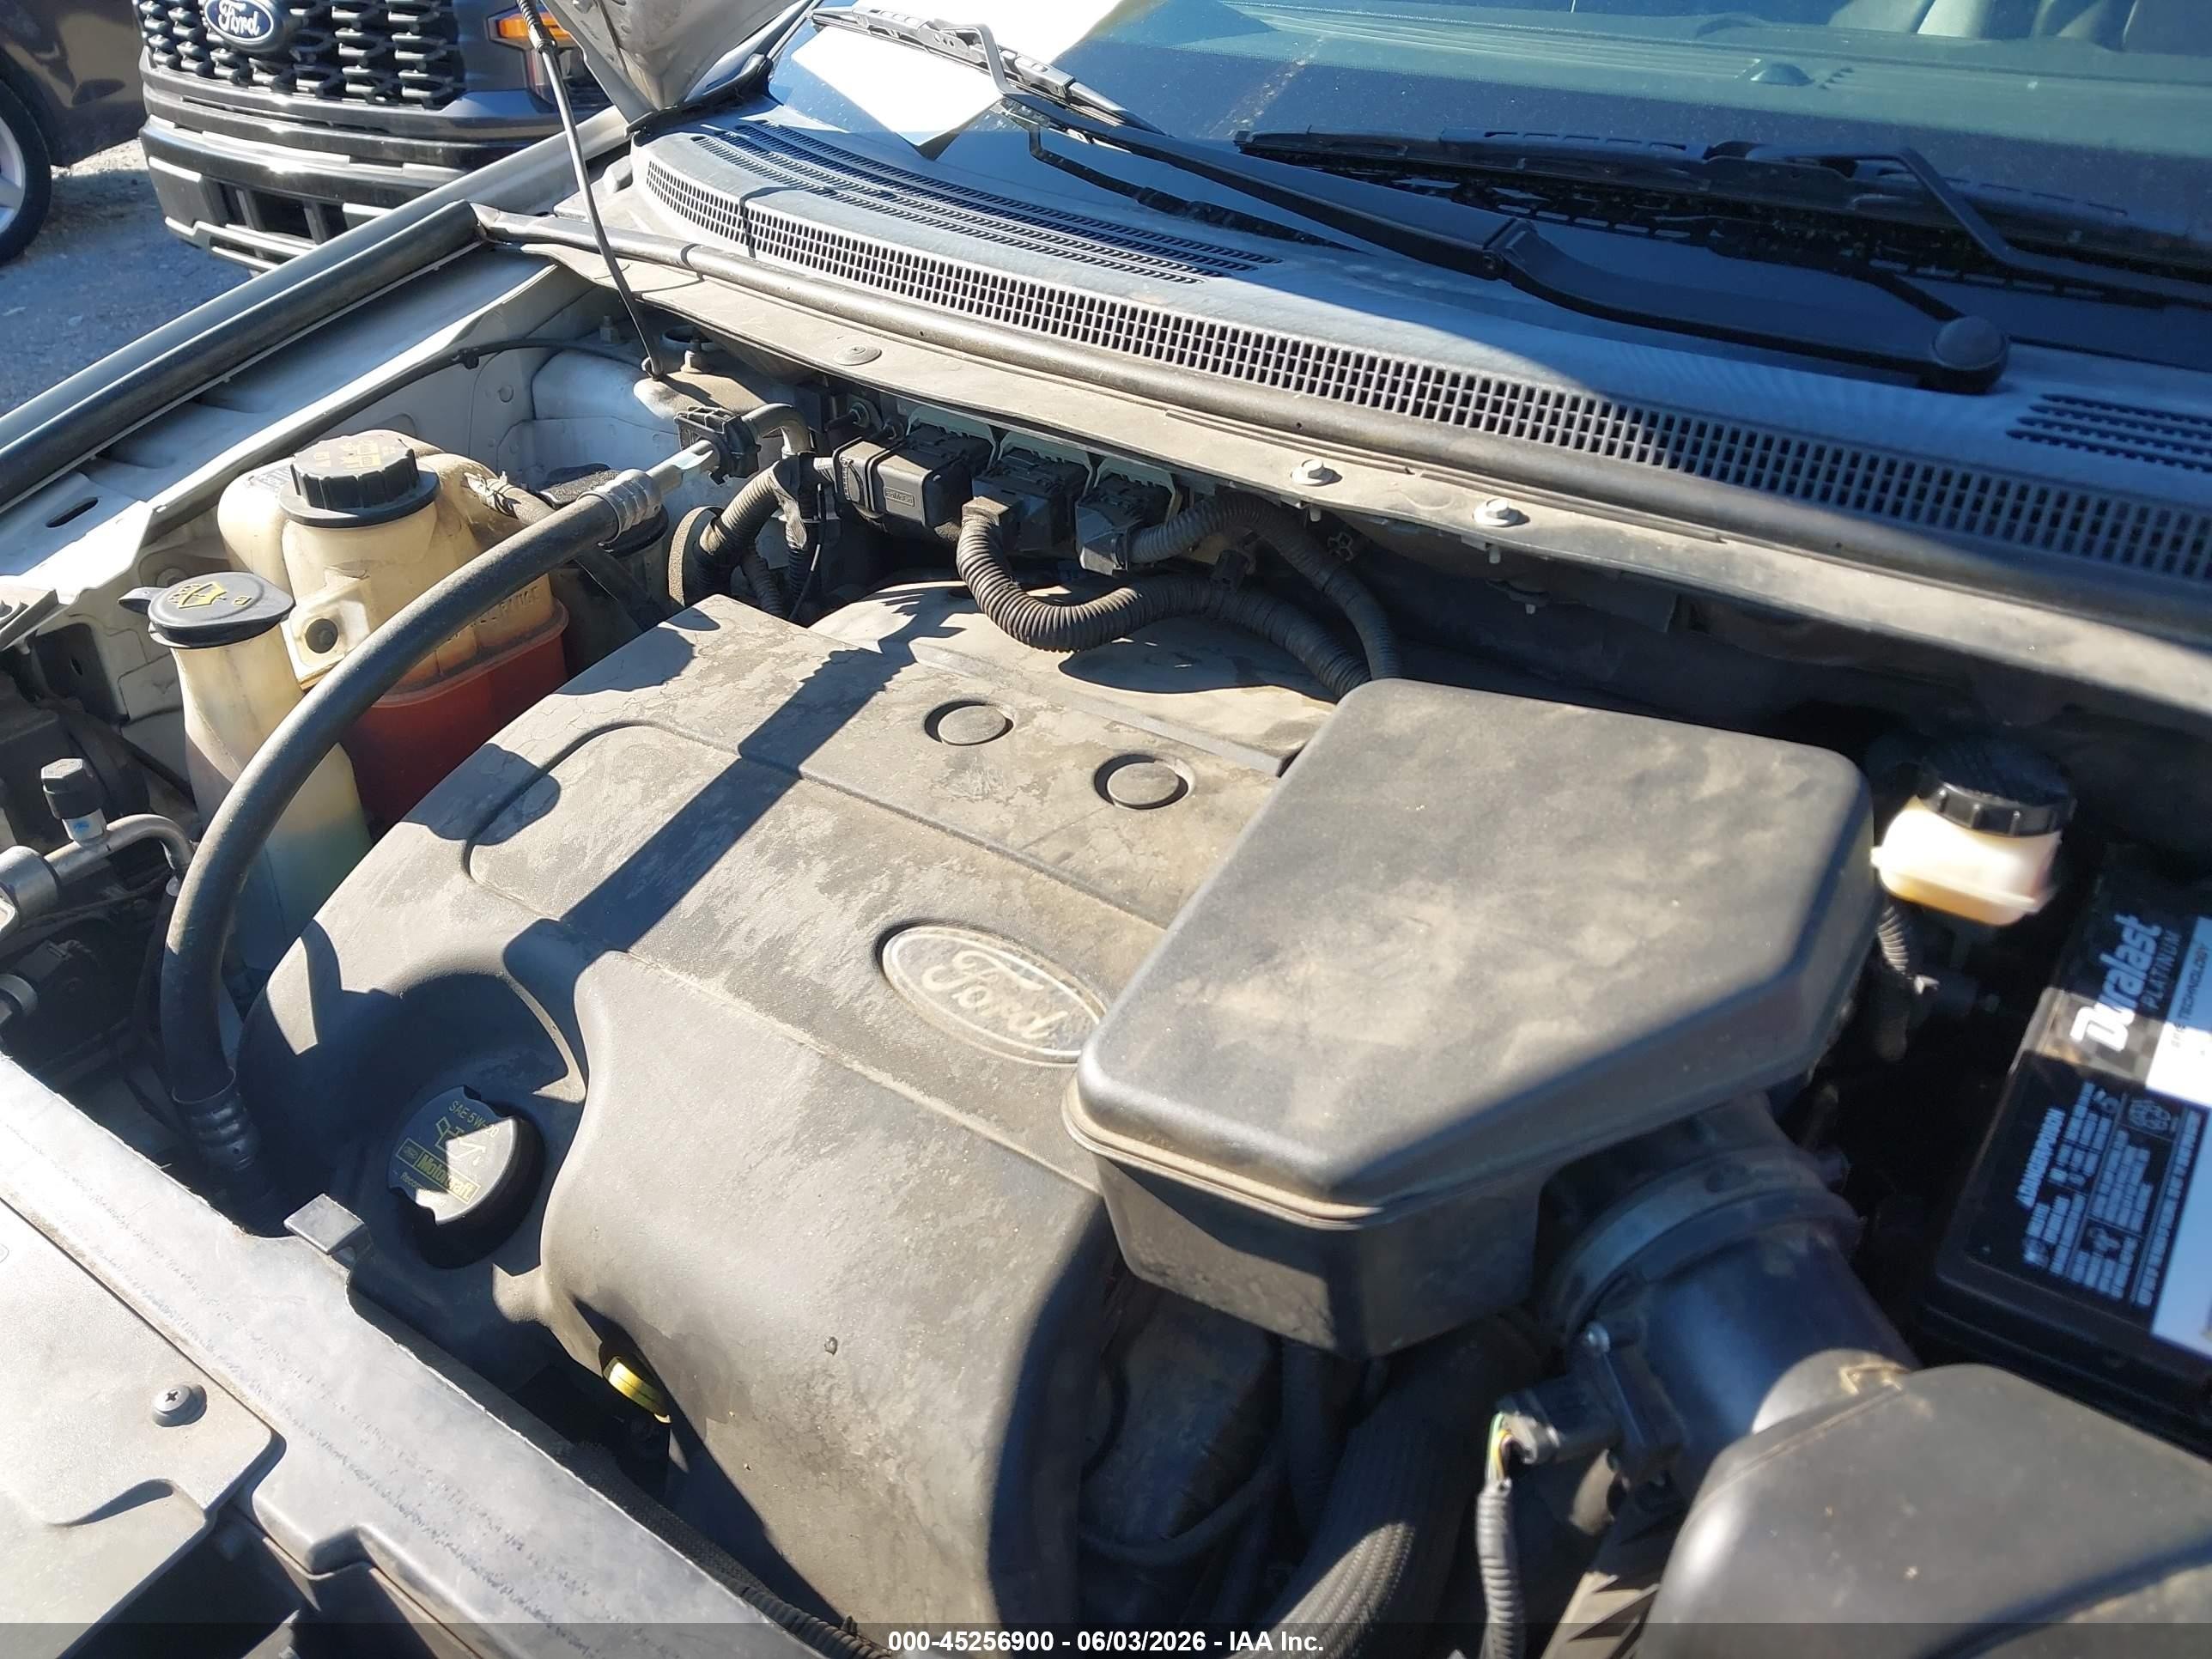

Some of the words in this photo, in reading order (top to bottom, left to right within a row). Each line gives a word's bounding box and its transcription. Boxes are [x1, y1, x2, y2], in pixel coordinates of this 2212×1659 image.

[218, 0, 260, 36] Ford
[921, 950, 1068, 1040] Ford
[2069, 914, 2162, 1052] Duralast
[2141, 929, 2182, 1011] PLATINUM
[2178, 944, 2209, 1021] TECHNOLOGY
[448, 1100, 470, 1120] SAE
[466, 1111, 500, 1139] 5W-20
[417, 1152, 476, 1203] Motorcraft
